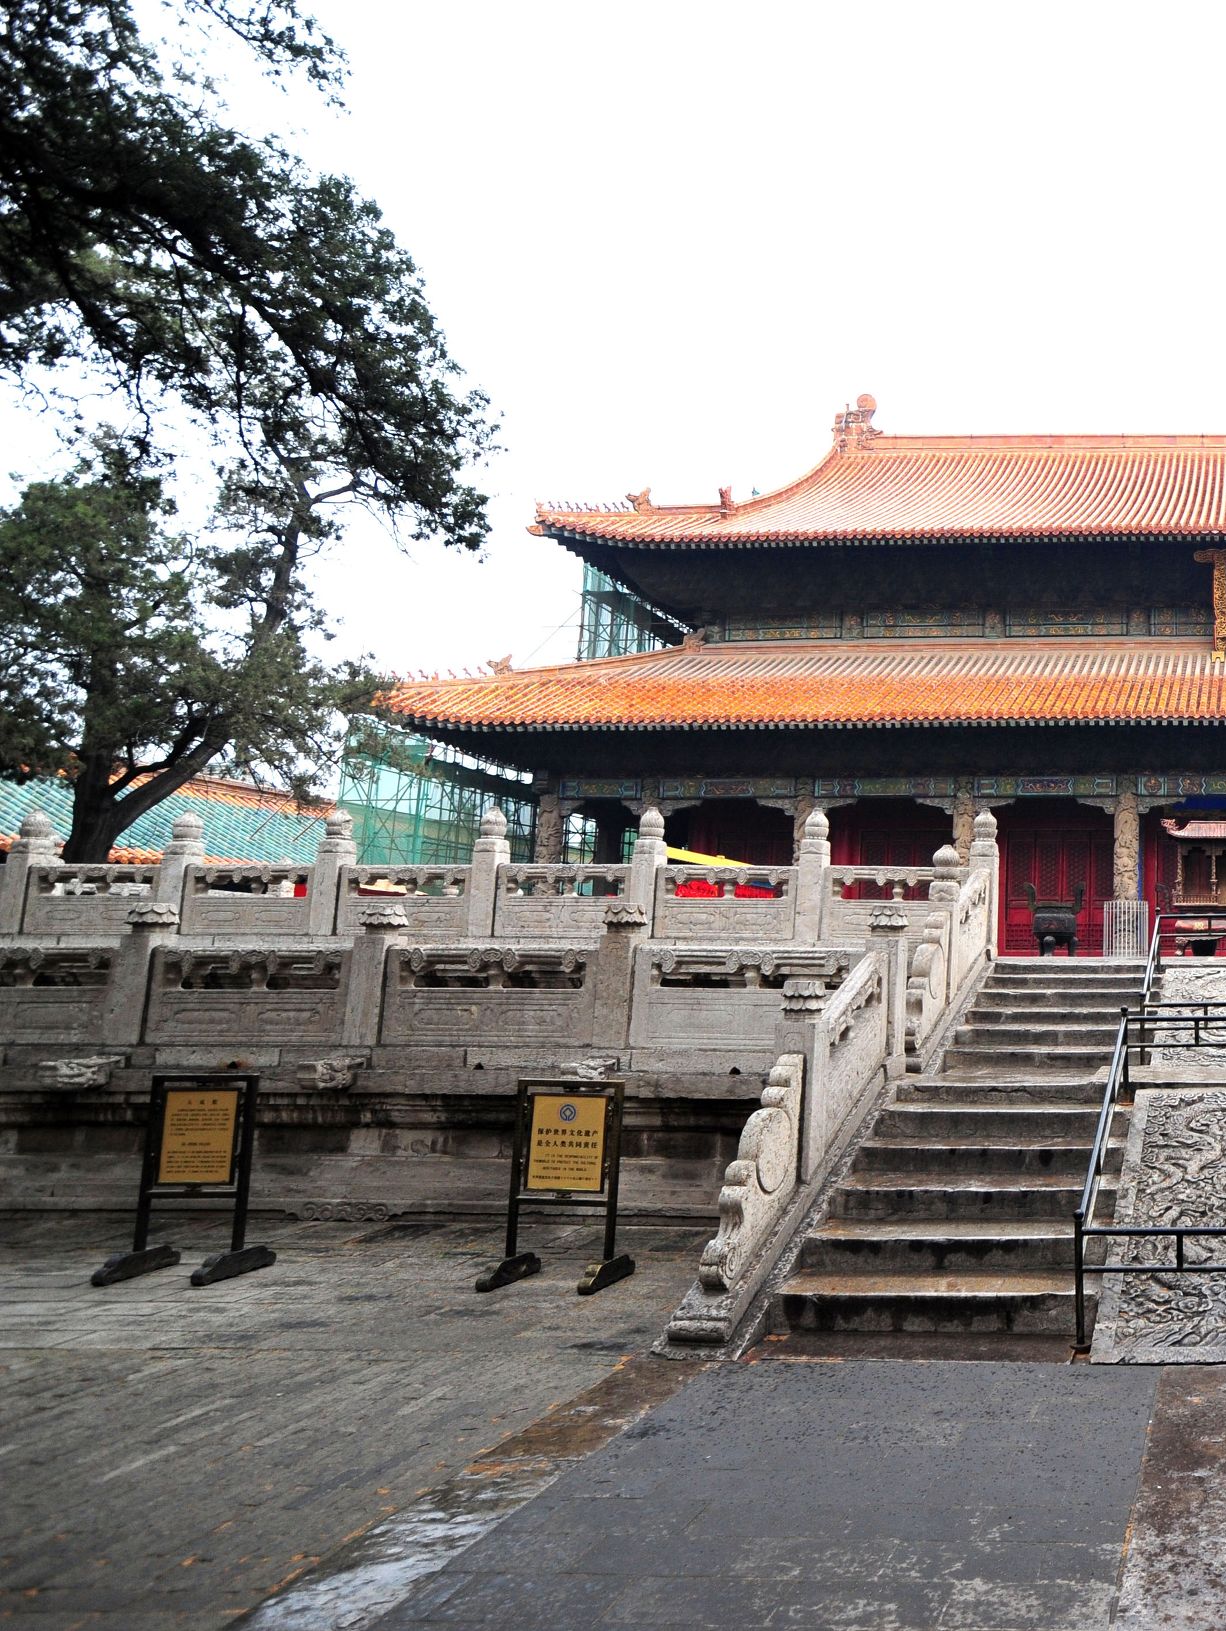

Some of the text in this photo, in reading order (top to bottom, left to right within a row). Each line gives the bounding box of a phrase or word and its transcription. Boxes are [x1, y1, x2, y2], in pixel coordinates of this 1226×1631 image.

[537, 1128, 599, 1137] 保护世界文化遗产
[536, 1139, 598, 1149] 是全人类共同责任
